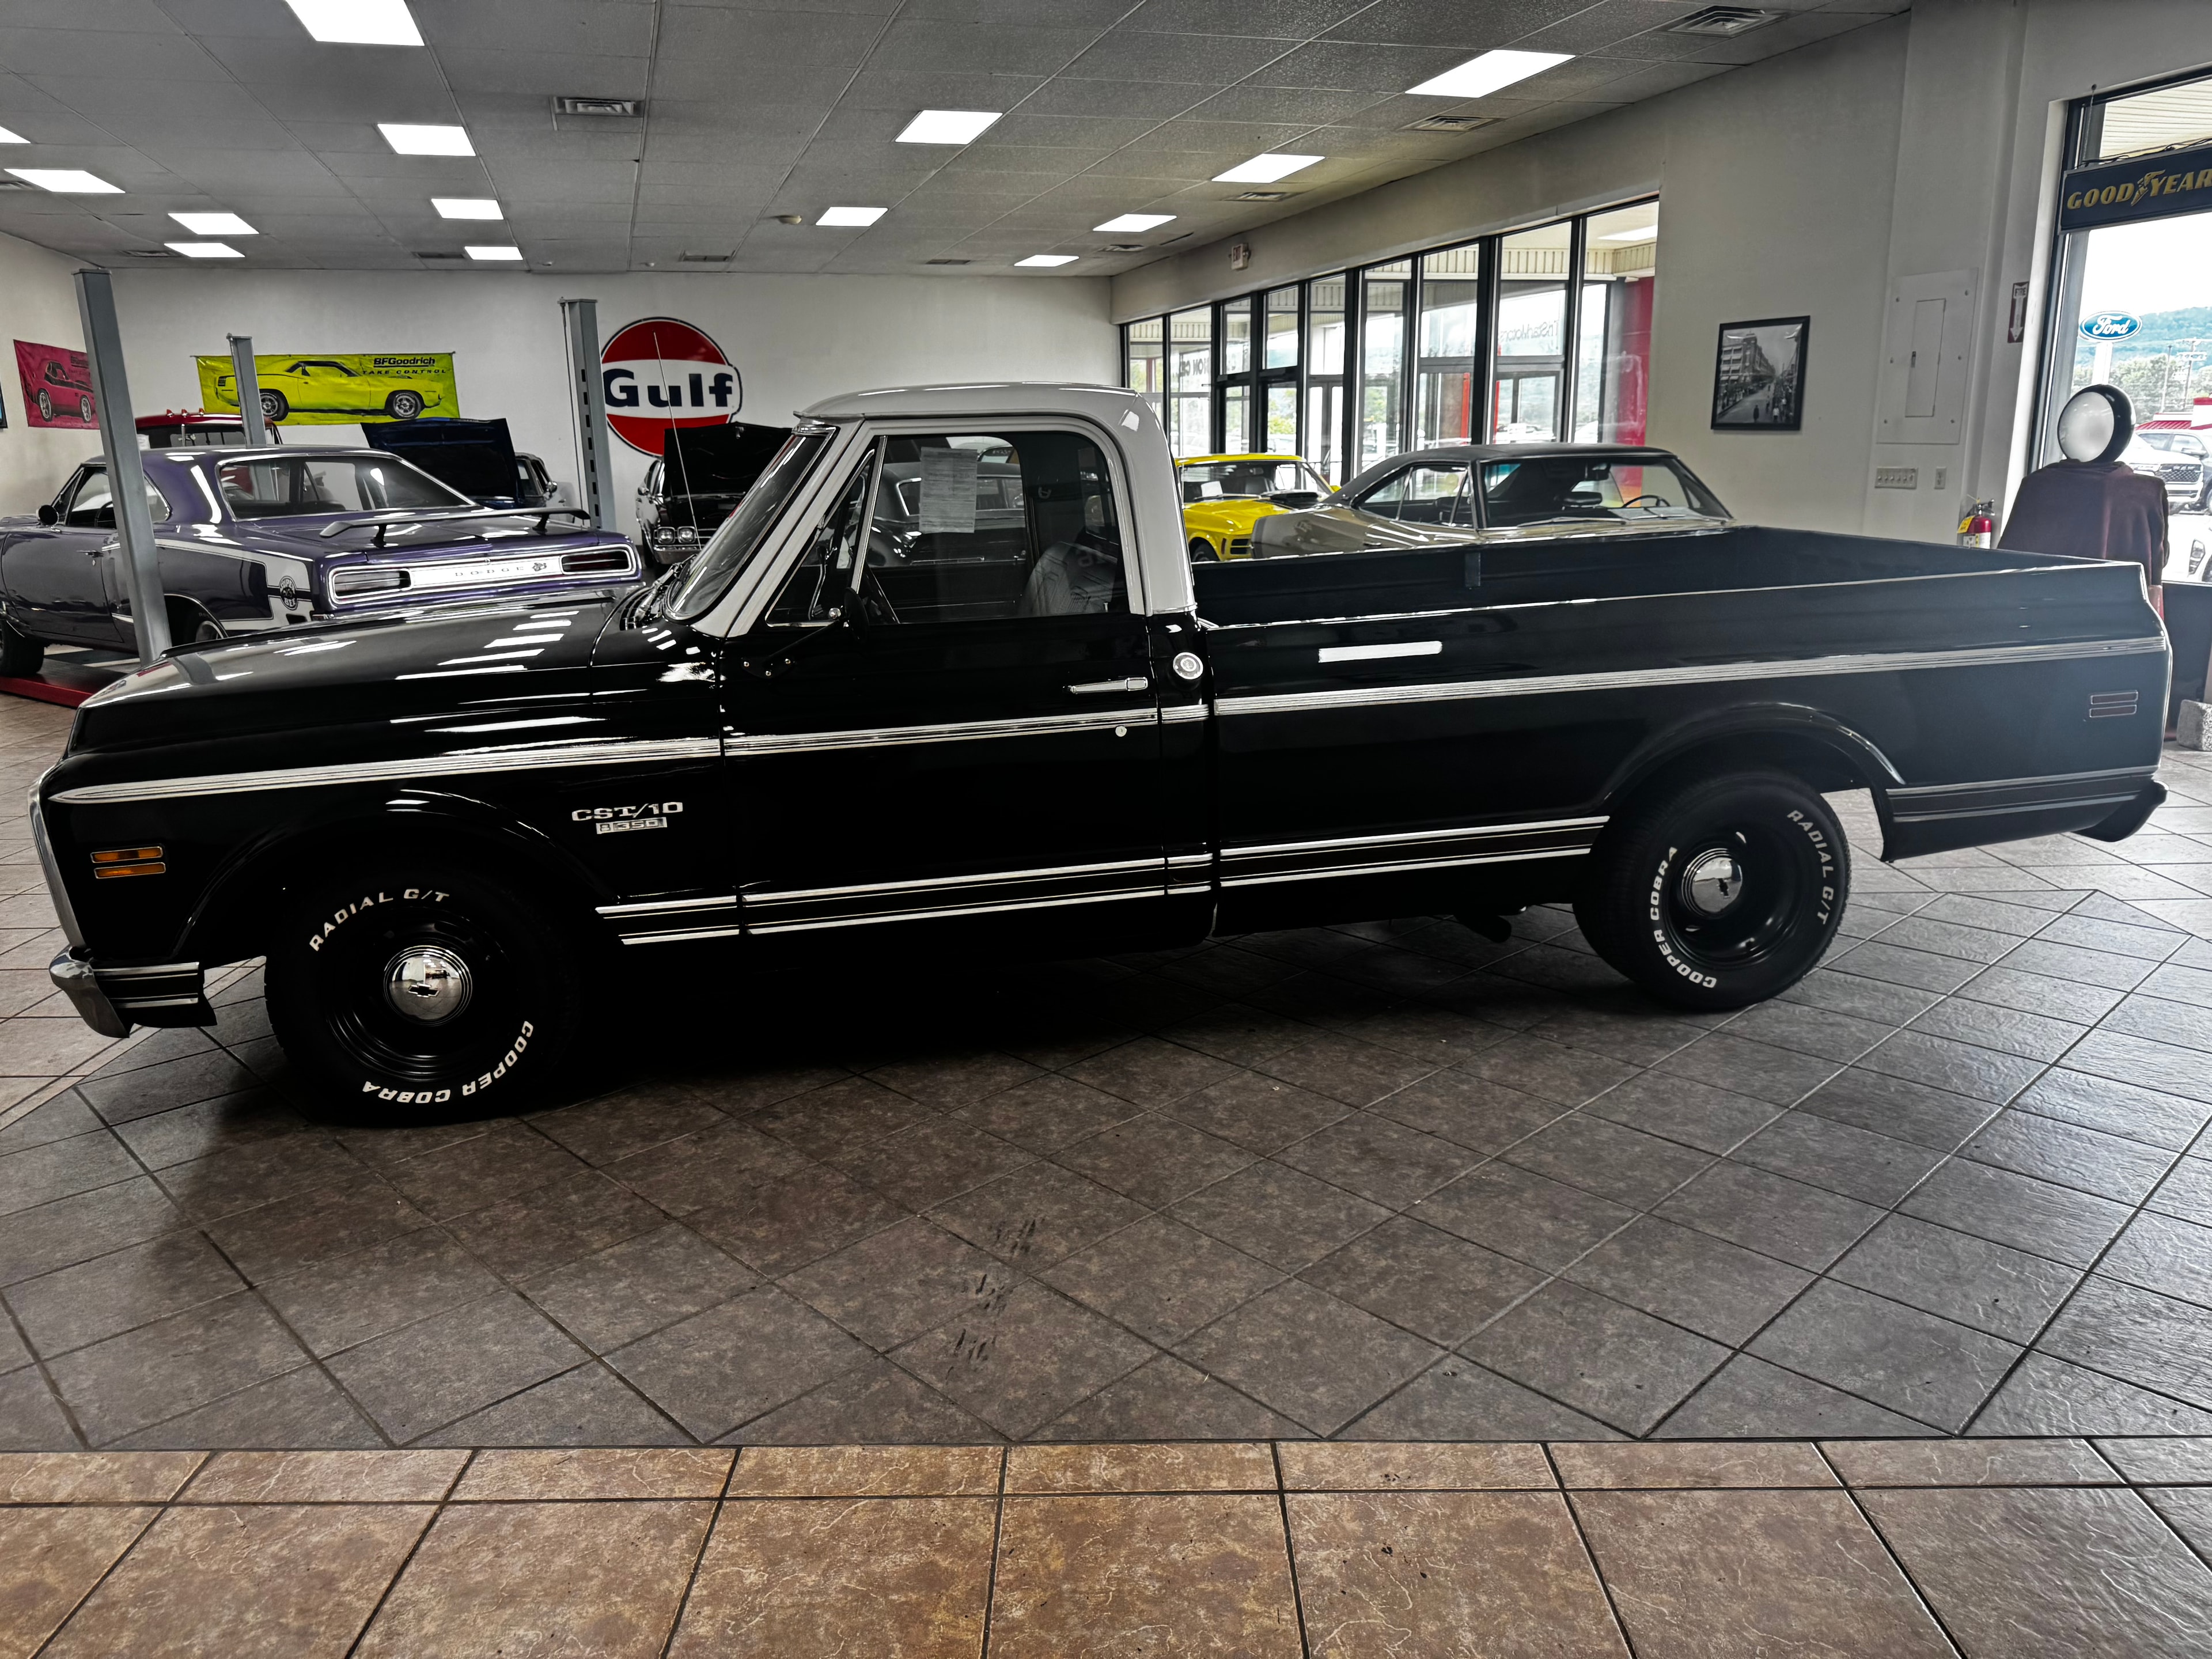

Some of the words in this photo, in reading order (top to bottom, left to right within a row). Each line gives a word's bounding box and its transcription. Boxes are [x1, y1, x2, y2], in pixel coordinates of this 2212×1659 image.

[2092, 315, 2131, 335] Ford
[374, 357, 435, 365] BFGoodrich
[603, 368, 733, 408] Gulf
[455, 566, 524, 577] DODGE
[571, 801, 684, 821] CST/10
[1786, 809, 1835, 878] RADIAL
[1650, 846, 1678, 921] COBRA
[309, 892, 394, 952] RADIAL
[1653, 929, 1717, 988] COOPER
[462, 1020, 534, 1096] COOPER
[362, 1081, 451, 1104] COBRA
